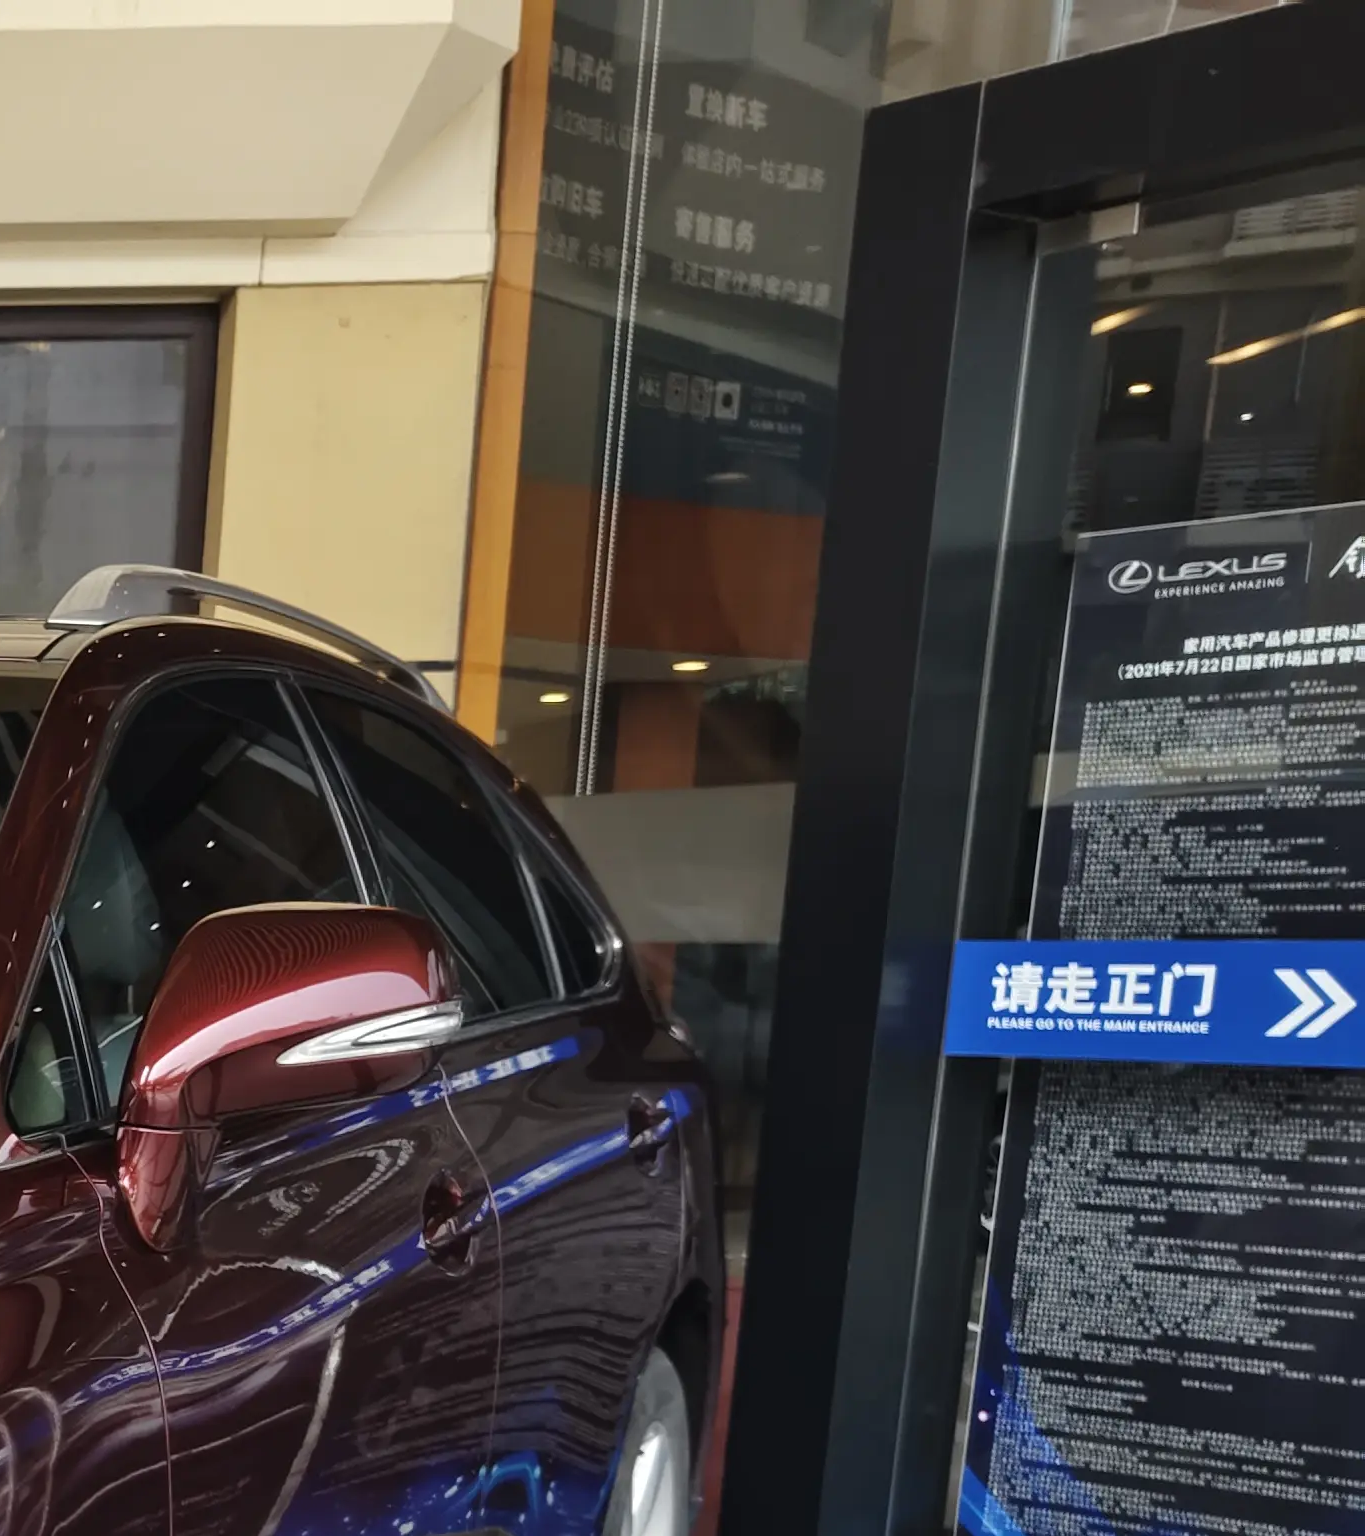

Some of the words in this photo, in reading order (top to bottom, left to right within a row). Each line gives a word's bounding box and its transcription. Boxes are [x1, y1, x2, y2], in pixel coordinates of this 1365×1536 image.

[1157, 552, 1287, 583] LEXUS
[1154, 582, 1225, 600] EXPERIENCE
[1228, 575, 1286, 593] AMAZING
[990, 961, 1218, 1018] 请走正门
[987, 1016, 1033, 1030] PLEASE
[1035, 1018, 1055, 1031] GO
[1057, 1018, 1074, 1031] TO
[1076, 1018, 1102, 1032] THE
[1103, 1019, 1136, 1033] MAIN
[1138, 1020, 1210, 1035] ENTRANCE
